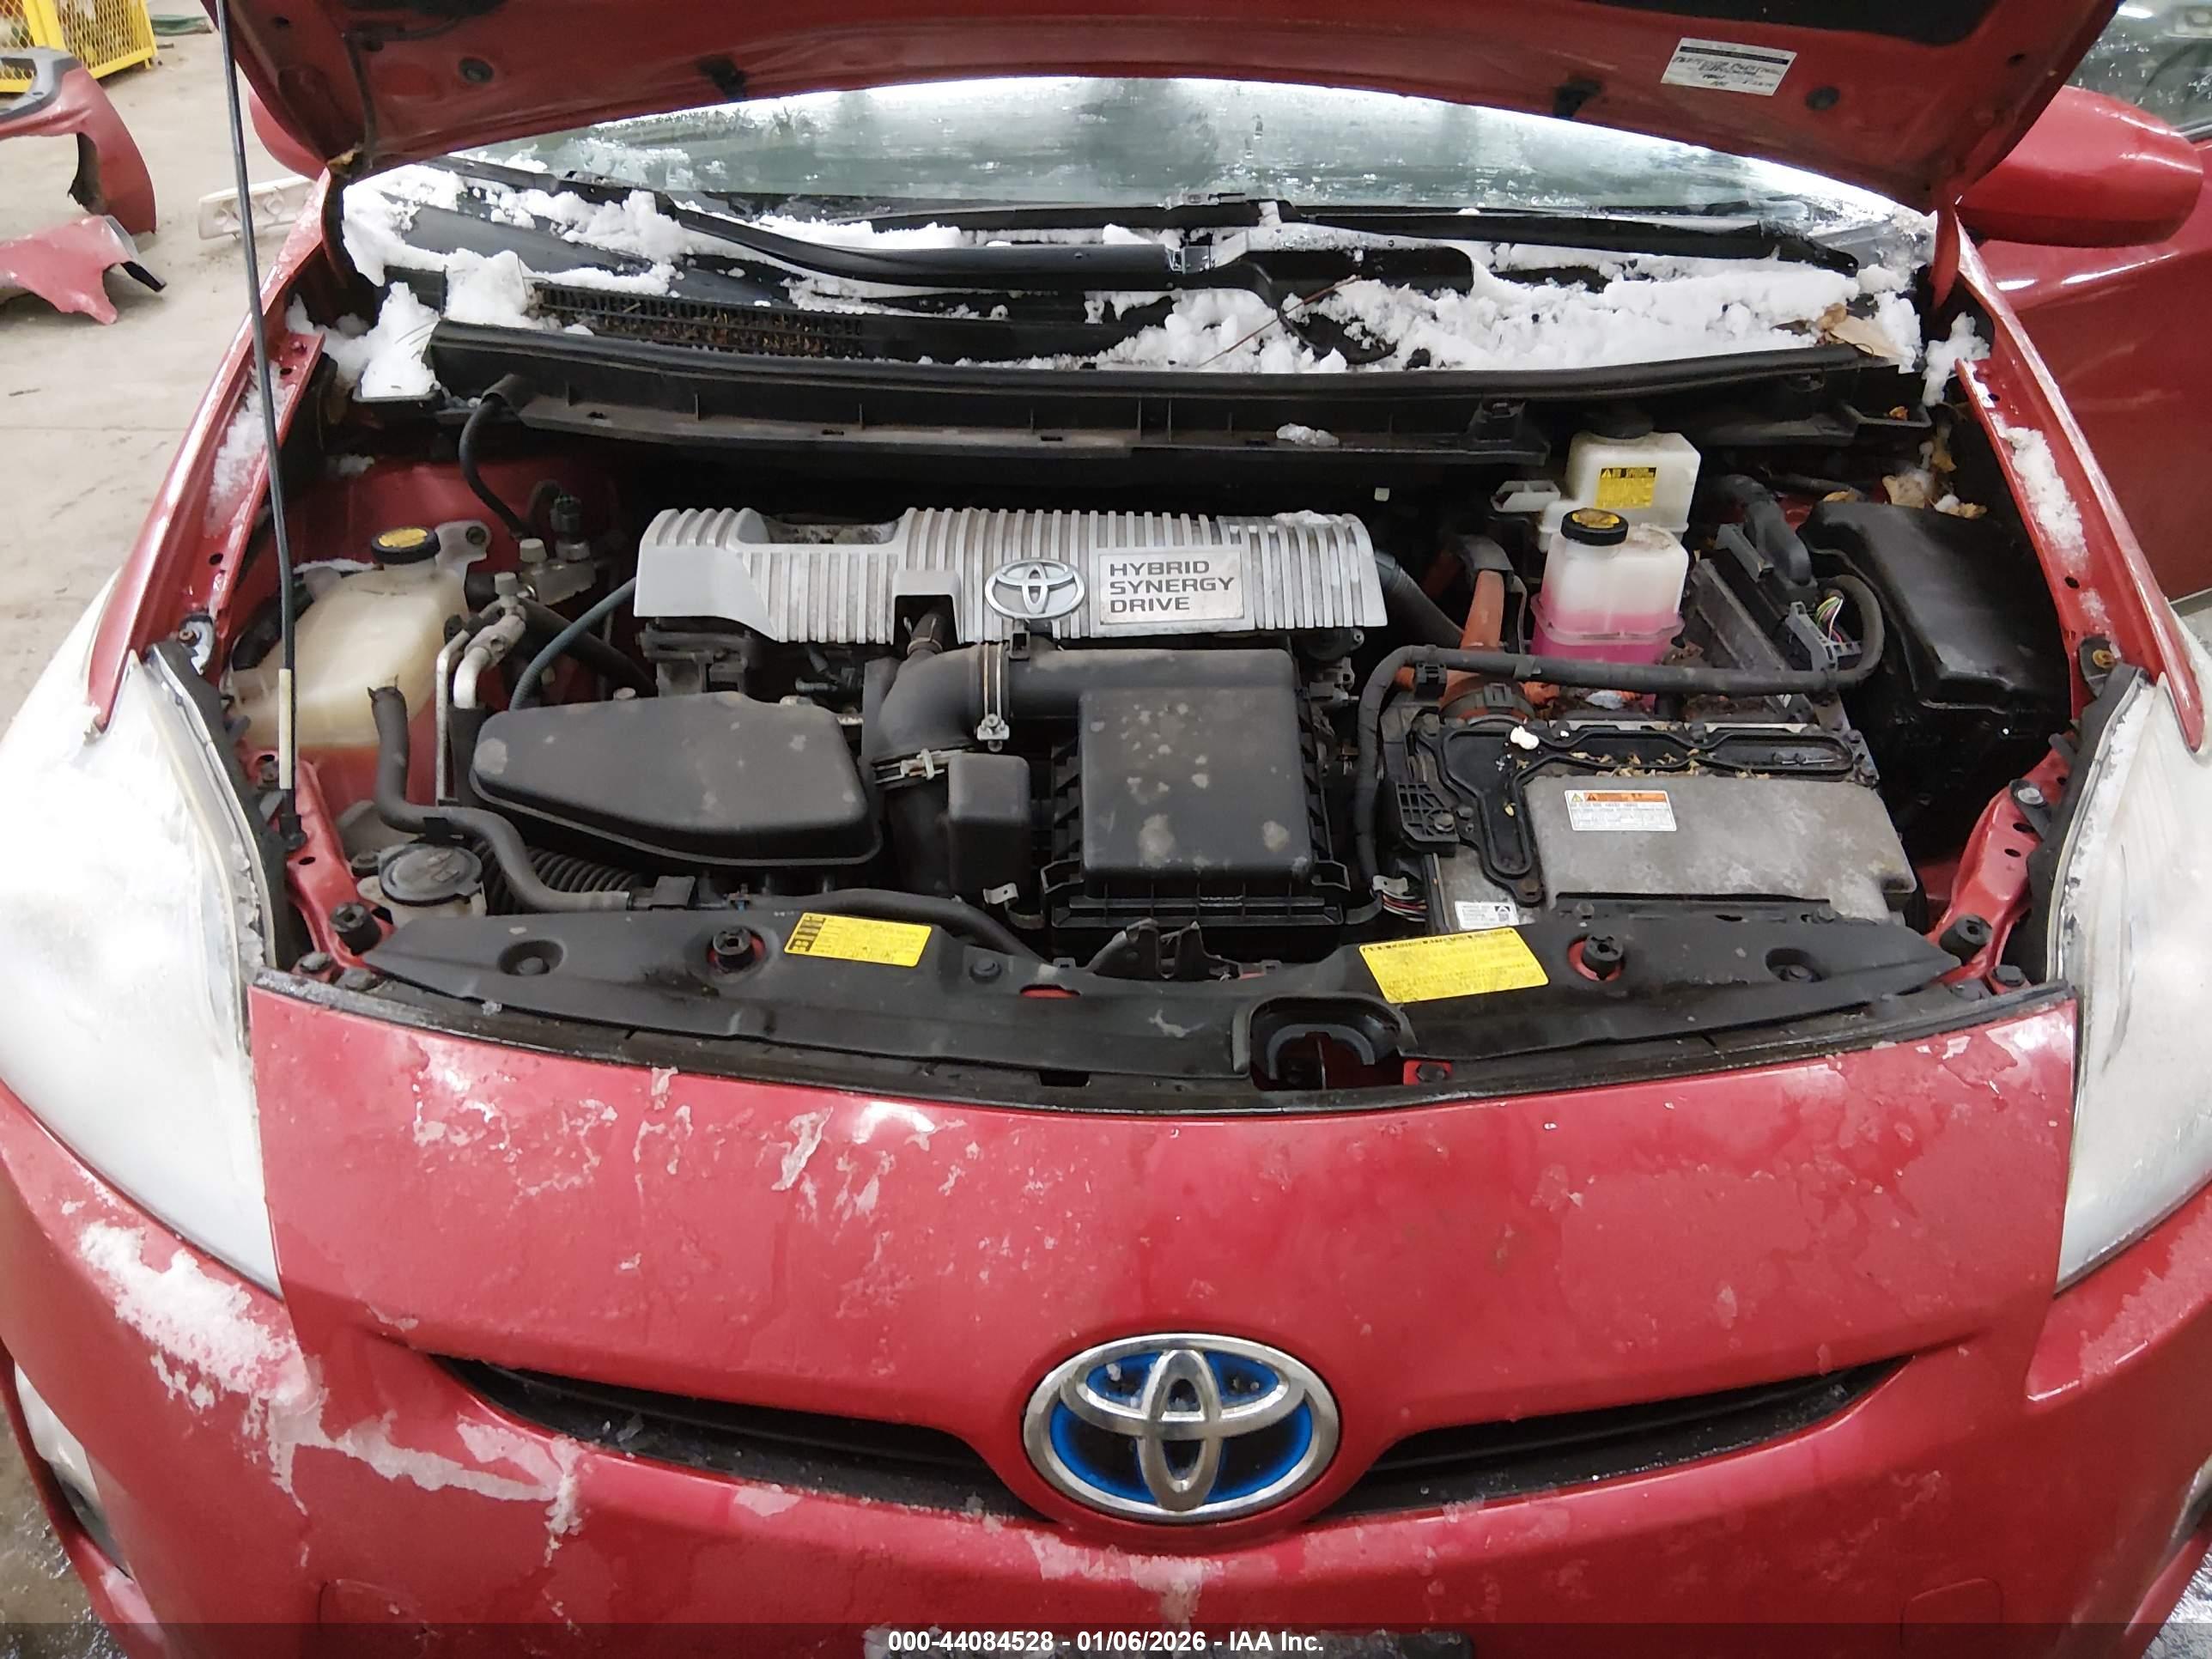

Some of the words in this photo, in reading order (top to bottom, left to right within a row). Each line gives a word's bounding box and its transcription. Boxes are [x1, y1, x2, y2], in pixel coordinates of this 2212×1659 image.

[1109, 561, 1210, 577] HYBRID
[1109, 577, 1235, 595] SYNERGY
[1110, 597, 1190, 613] DRIVE
